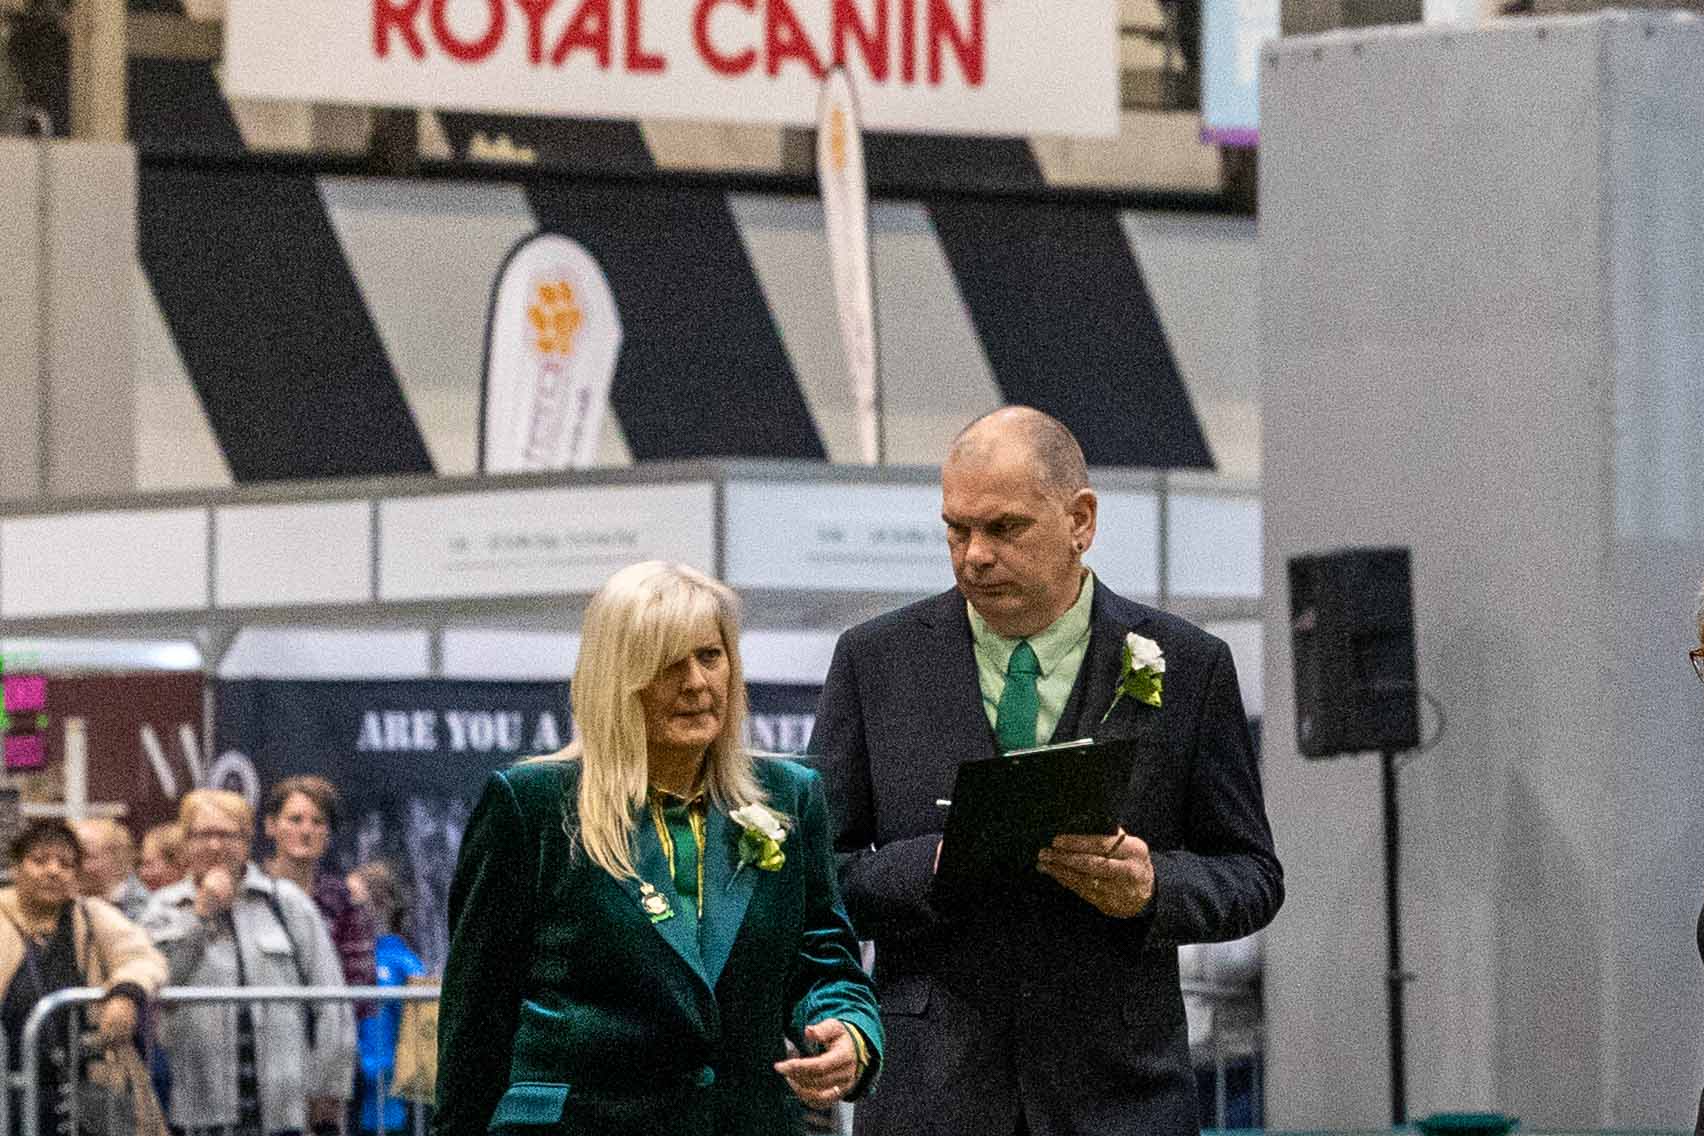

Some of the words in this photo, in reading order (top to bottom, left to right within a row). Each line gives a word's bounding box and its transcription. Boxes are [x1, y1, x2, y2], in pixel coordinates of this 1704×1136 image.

[370, 0, 667, 74] ROYAL
[690, 0, 985, 87] CANIN
[356, 710, 438, 752] ARE
[444, 710, 523, 752] YOU
[531, 711, 562, 752] A
